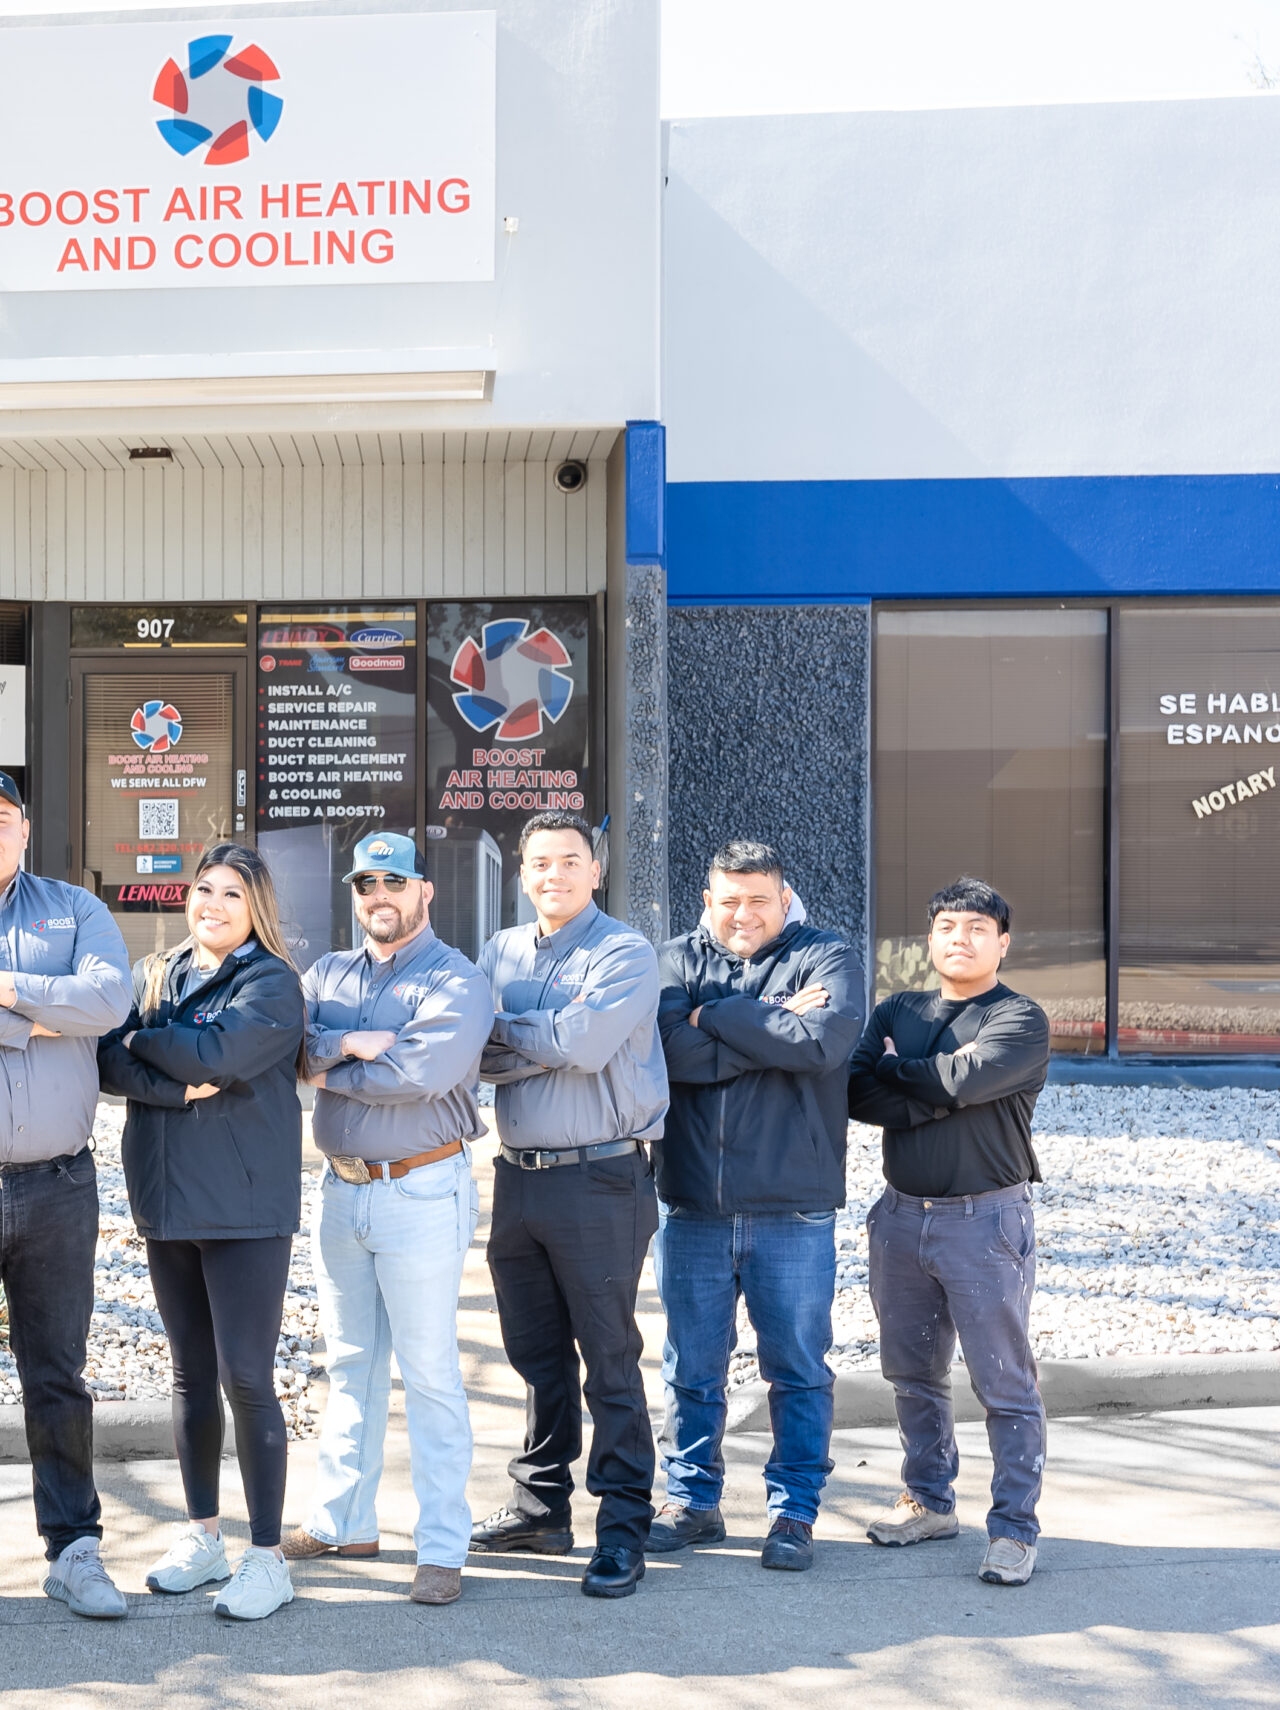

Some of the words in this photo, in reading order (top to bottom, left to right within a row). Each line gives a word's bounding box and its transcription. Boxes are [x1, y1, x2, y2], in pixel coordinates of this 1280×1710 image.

[163, 185, 243, 222] AIR
[261, 178, 470, 218] HEATING
[57, 236, 156, 272] AND
[174, 229, 394, 268] COOLING
[137, 619, 174, 638] 907
[261, 631, 329, 648] LENNOX
[357, 633, 398, 644] Carrier
[352, 659, 402, 667] Goodman
[268, 685, 323, 696] INSTALL
[326, 683, 352, 696] A/C
[268, 702, 325, 713] SERVICE
[328, 702, 377, 712] REPAIR
[1159, 693, 1197, 714] SE
[1207, 692, 1280, 714] HABL
[268, 719, 367, 730] MAINTENANCE
[1167, 723, 1280, 745] ESPANO
[268, 737, 305, 748] DUCT
[308, 736, 377, 747] CLEANING
[108, 754, 144, 765] BOOST
[145, 754, 163, 764] AIR
[165, 754, 209, 764] HEATING
[268, 754, 305, 765] DUCT
[308, 754, 406, 765] REPLACEMENT
[472, 748, 546, 766] BOOST
[123, 764, 146, 774] AND
[147, 764, 194, 773] COOLING
[111, 778, 127, 788] WE
[129, 778, 160, 788] SERVE
[162, 778, 181, 787] ALL
[183, 778, 207, 787] DFW
[268, 771, 314, 782] BOOTS
[317, 771, 340, 782] AIR
[344, 771, 403, 782] HEATING
[446, 770, 483, 788] AIR
[487, 770, 578, 788] HEATING
[269, 789, 278, 799] &
[281, 789, 341, 799] COOLING
[1192, 766, 1276, 819] NOTARY
[438, 791, 484, 809] AND
[489, 791, 585, 809] COOLING
[269, 806, 310, 818] (NEED
[313, 806, 323, 817] A
[326, 805, 386, 817] BOOST?)
[117, 885, 185, 901] LENNOX
[47, 917, 75, 926] BOOST
